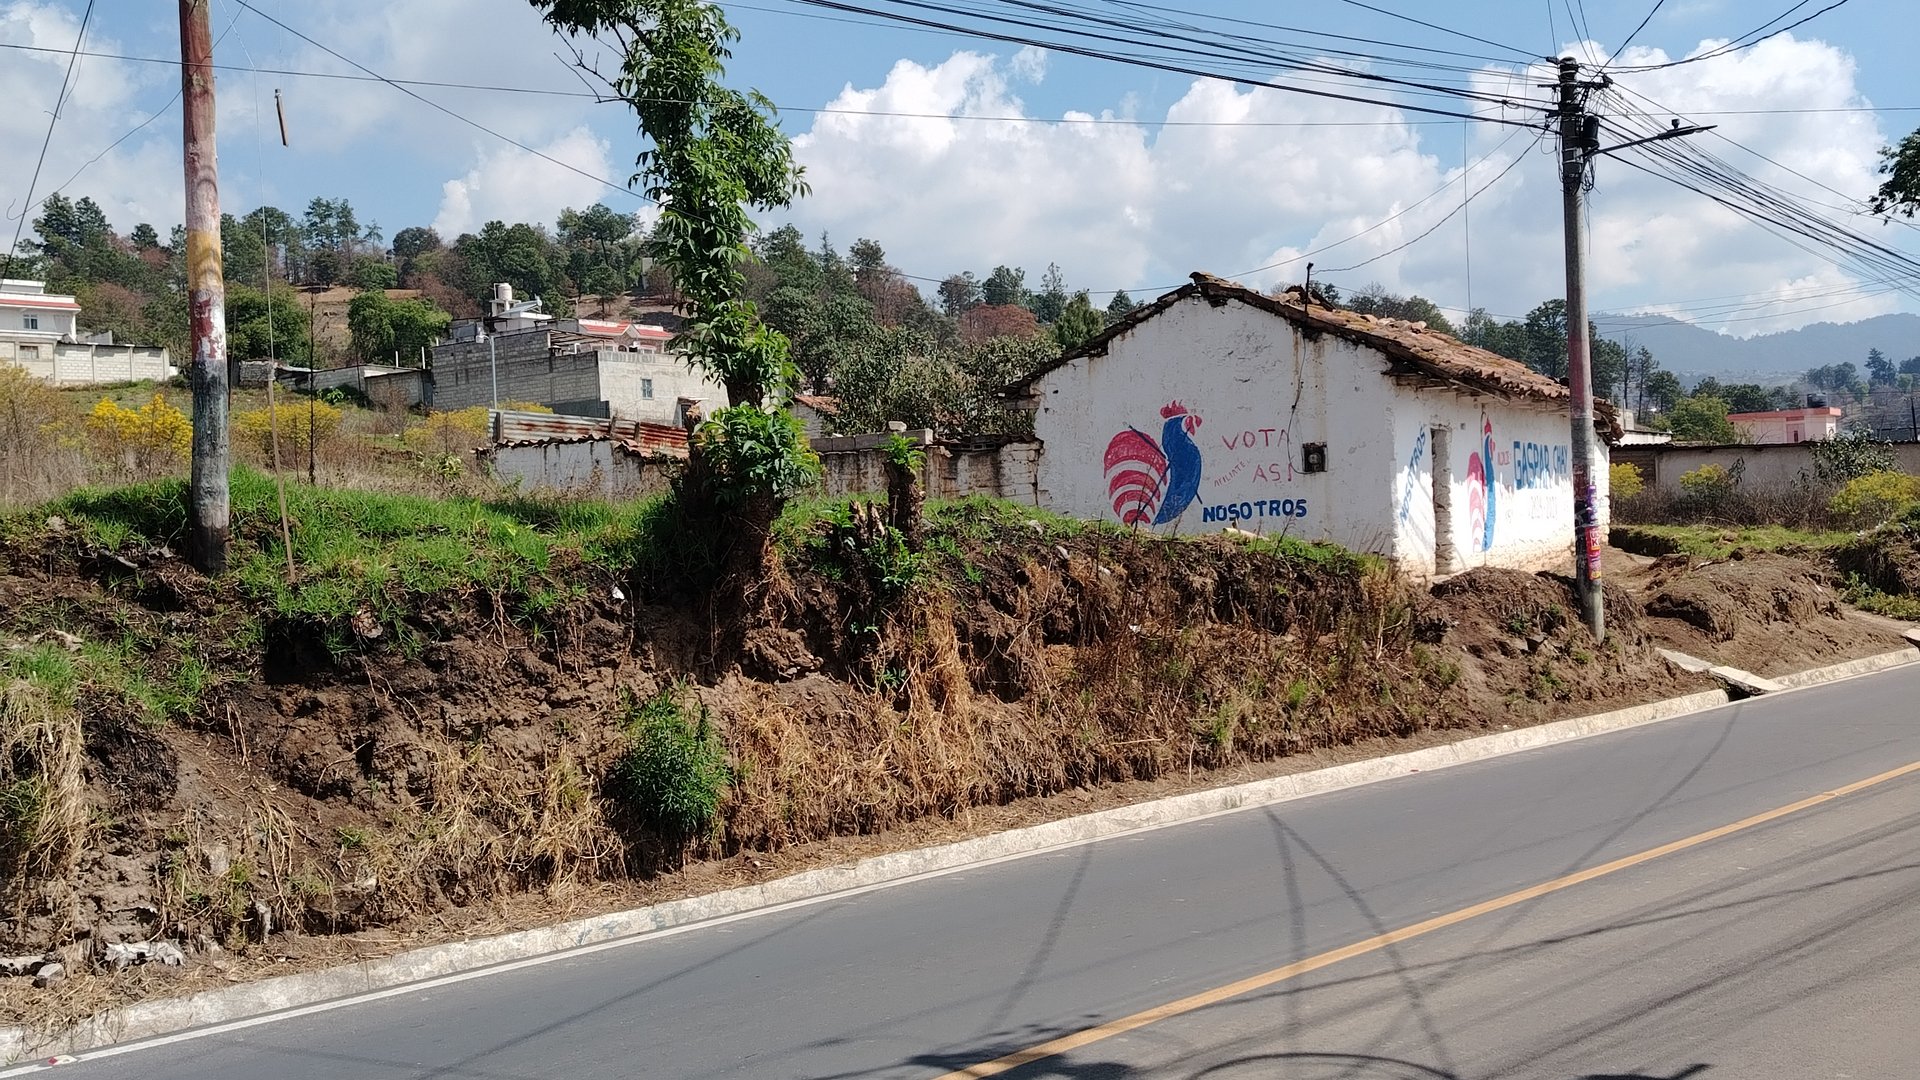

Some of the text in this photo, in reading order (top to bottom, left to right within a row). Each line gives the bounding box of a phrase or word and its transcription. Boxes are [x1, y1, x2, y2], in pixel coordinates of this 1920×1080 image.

[1221, 429, 1290, 450] VOTA
[1400, 424, 1427, 527] NOSOTROS
[1513, 441, 1552, 490] GASPAR
[1202, 498, 1308, 523] NOSOTROS
